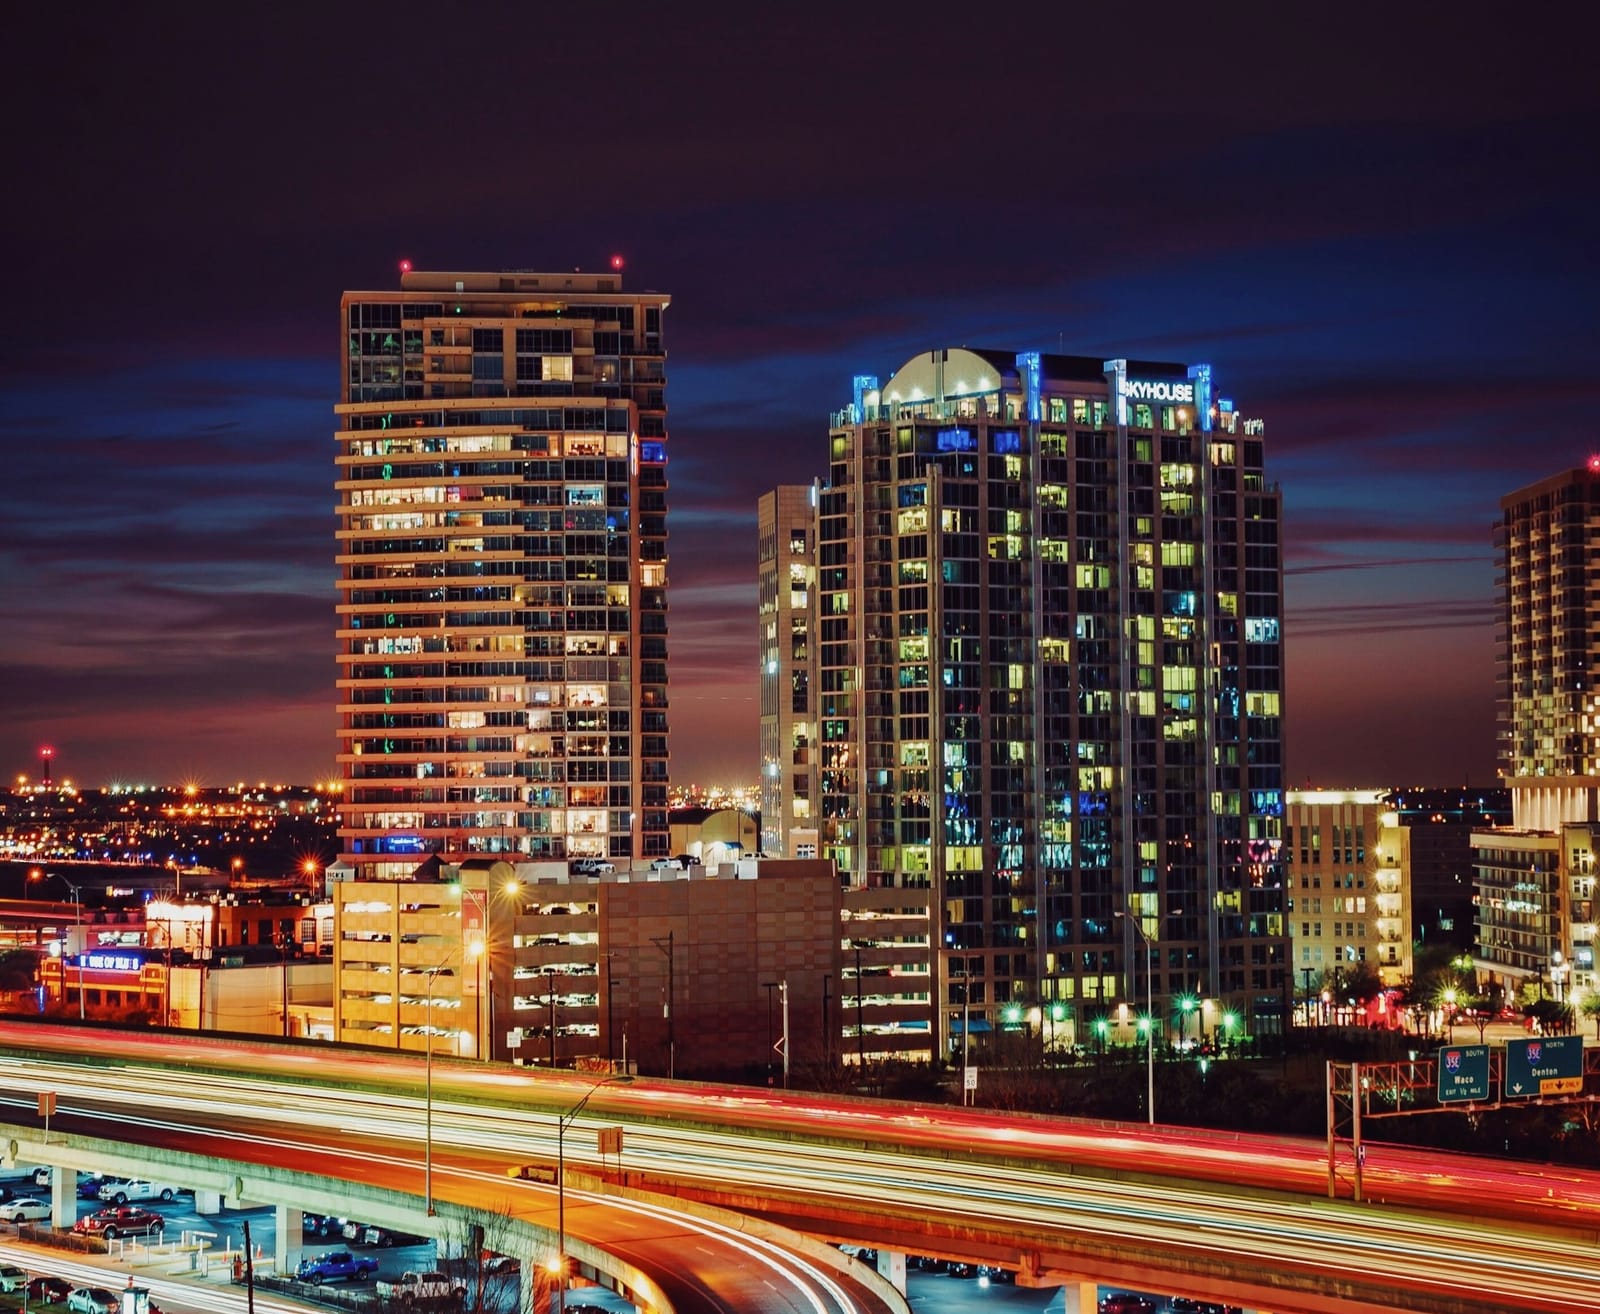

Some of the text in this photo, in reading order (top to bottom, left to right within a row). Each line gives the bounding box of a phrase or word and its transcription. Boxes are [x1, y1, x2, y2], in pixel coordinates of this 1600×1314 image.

[80, 955, 104, 968] HUSE
[115, 957, 138, 970] BLUS
[1465, 1049, 1484, 1057] SOUTH
[1531, 1067, 1558, 1077] Denton
[1454, 1075, 1474, 1084] Waco
[1542, 1082, 1553, 1090] EXIT
[1445, 1088, 1457, 1096] EXIT
